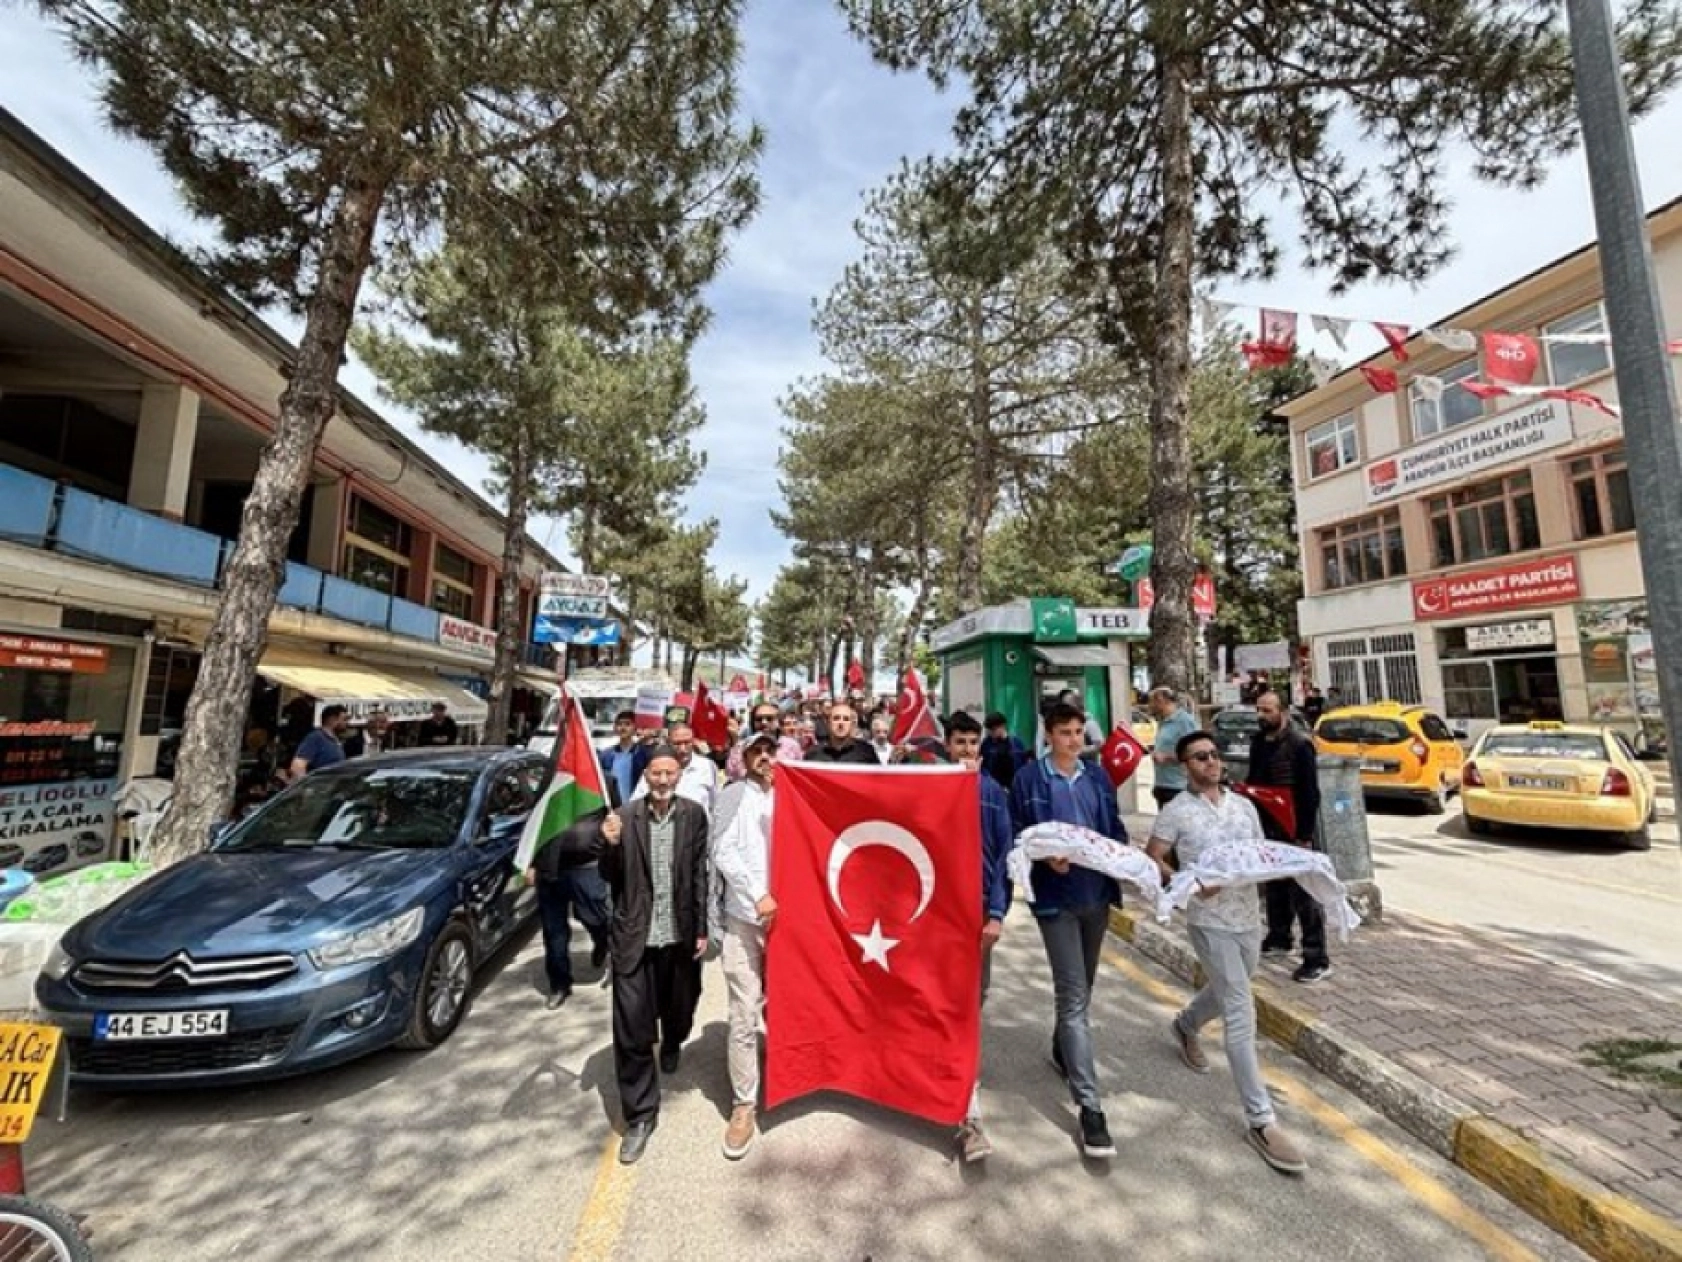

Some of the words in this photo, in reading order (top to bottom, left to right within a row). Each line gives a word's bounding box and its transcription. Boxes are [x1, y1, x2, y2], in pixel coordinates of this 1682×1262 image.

[1402, 438, 1469, 470] CUMHURİYET
[1470, 428, 1503, 446] HALK
[1503, 404, 1556, 436] PARTİSİ
[1472, 430, 1545, 464] BAŞKANLIĞI
[1449, 576, 1507, 597] SAADET
[1509, 562, 1574, 587] PARTİSİ
[543, 598, 602, 613] AYGAZ
[1090, 615, 1129, 628] TEB
[22, 808, 36, 822] A
[42, 802, 83, 817] CAR
[107, 1015, 134, 1037] 44
[141, 1014, 174, 1035] EJ
[181, 1012, 222, 1034] 554
[20, 1032, 53, 1062] Car
